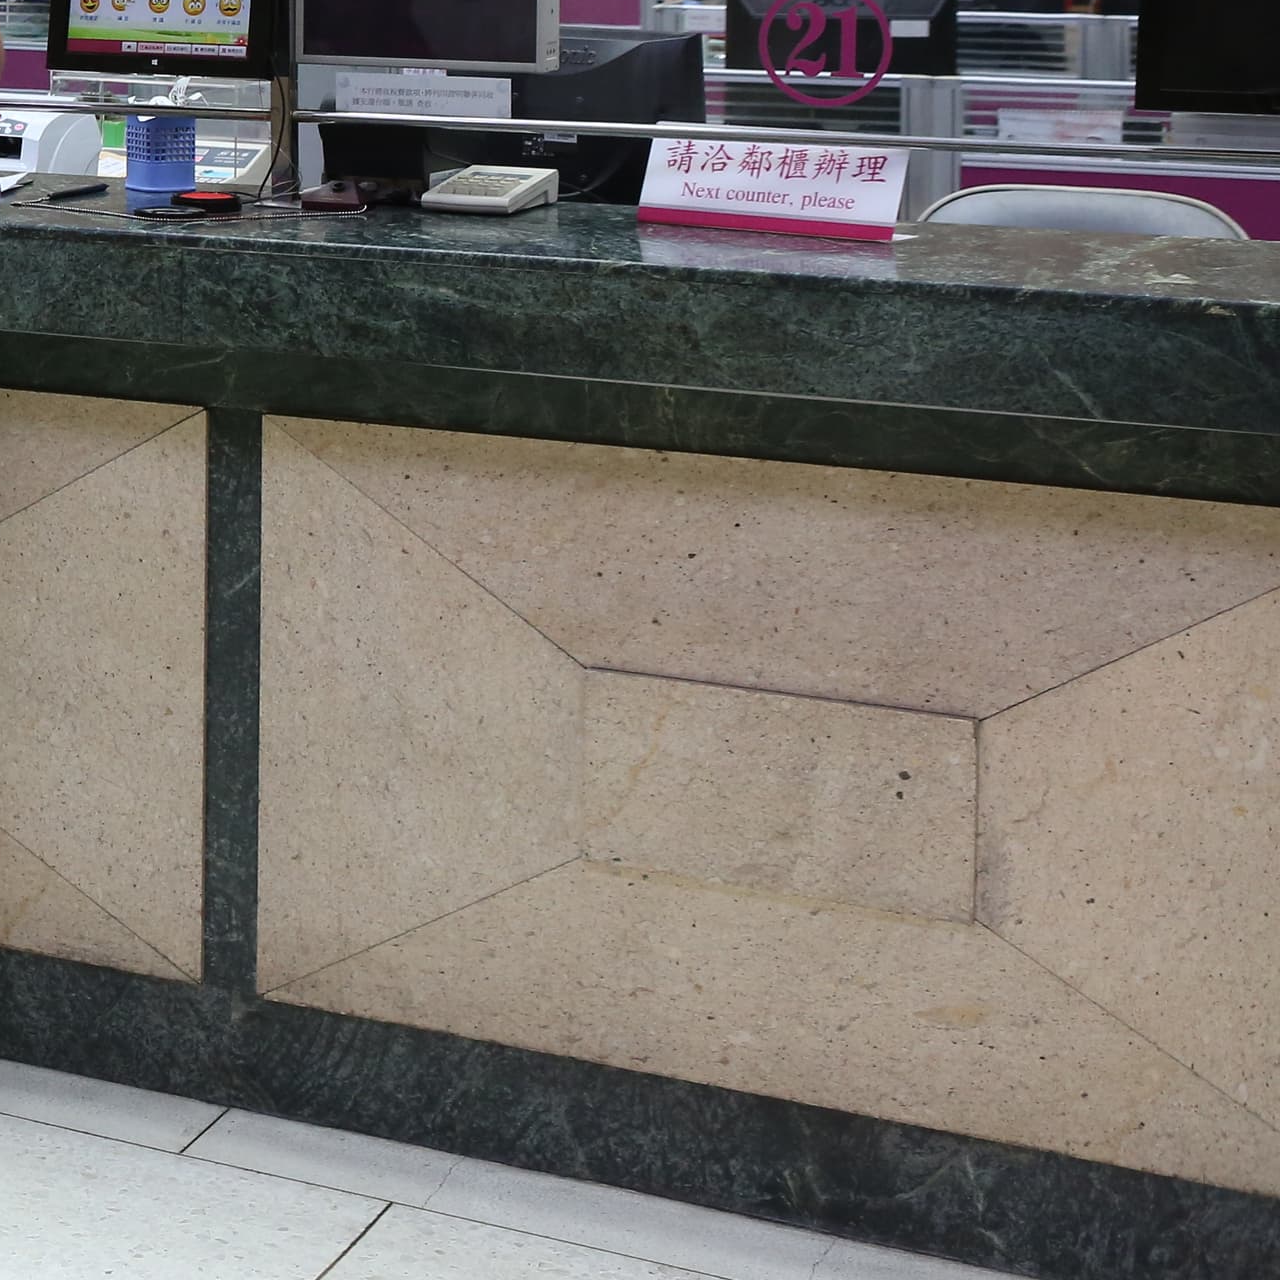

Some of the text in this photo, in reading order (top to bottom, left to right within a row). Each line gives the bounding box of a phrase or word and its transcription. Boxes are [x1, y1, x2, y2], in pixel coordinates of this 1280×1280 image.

[785, 2, 865, 79] 21
[666, 139, 889, 184] 請洽鄰櫃辦理
[681, 181, 856, 211] Next counter, please
